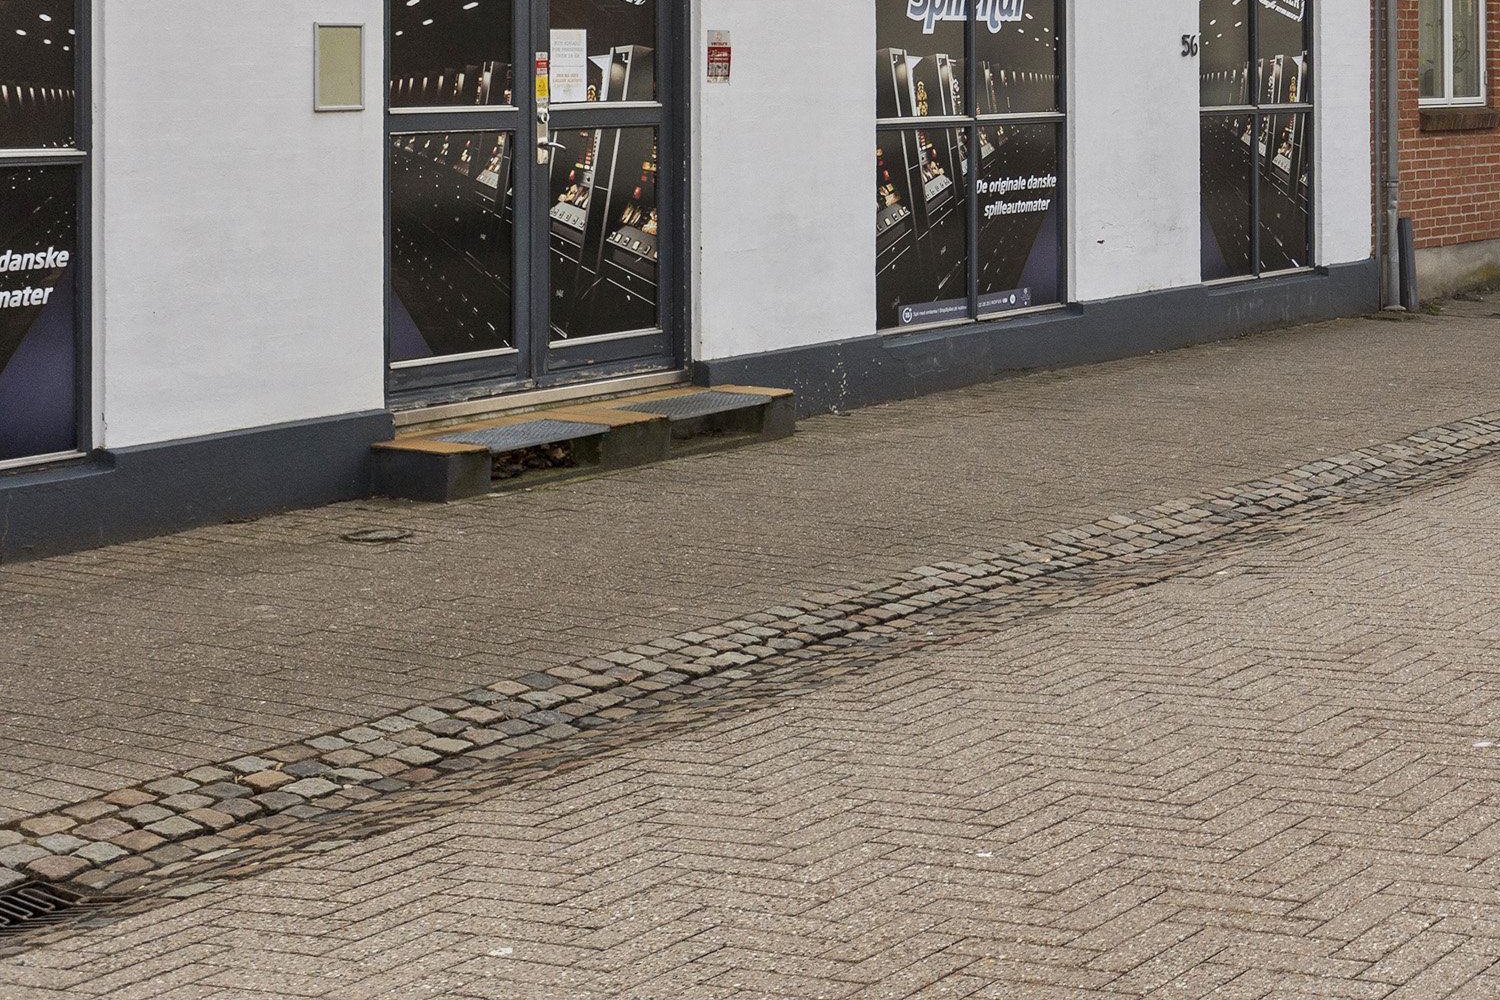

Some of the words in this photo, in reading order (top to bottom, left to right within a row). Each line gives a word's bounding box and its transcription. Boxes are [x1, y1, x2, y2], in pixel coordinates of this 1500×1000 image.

[1181, 34, 1199, 57] 56
[976, 179, 988, 194] De
[989, 176, 1026, 195] originale
[1027, 173, 1057, 189] danske
[983, 198, 1051, 220] spilleautomater
[0, 246, 70, 272] danske
